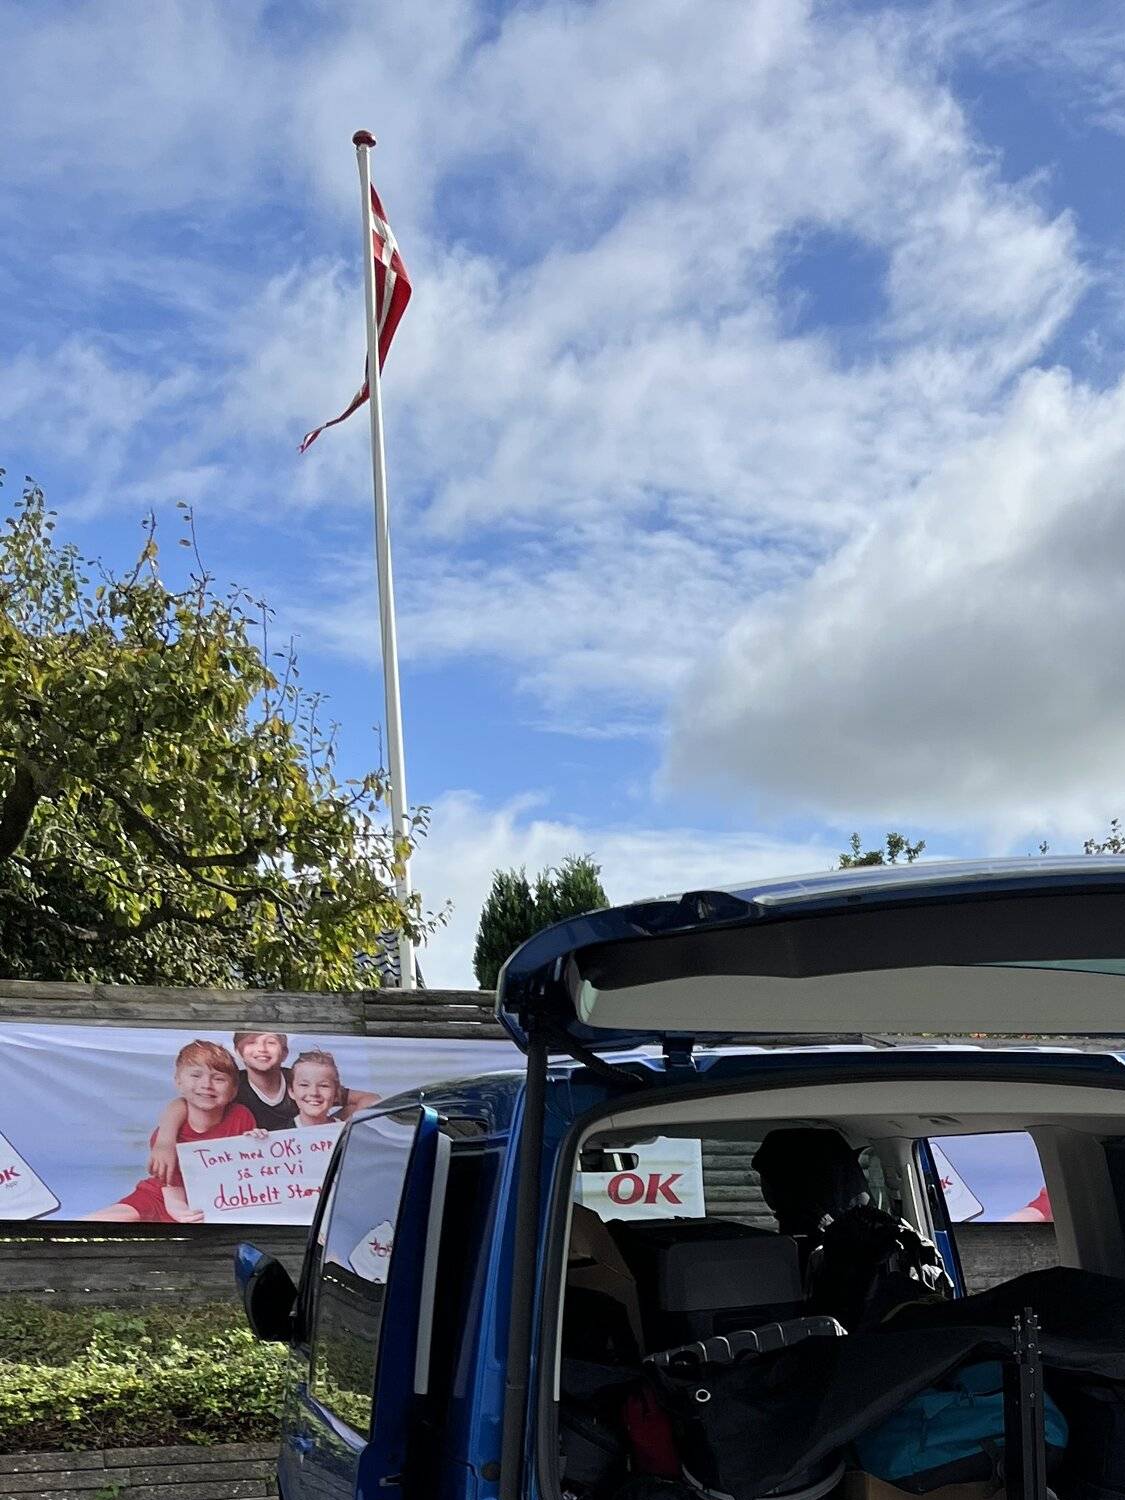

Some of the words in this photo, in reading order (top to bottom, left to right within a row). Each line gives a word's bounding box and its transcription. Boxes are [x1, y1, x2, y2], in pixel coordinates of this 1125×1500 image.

[193, 1149, 233, 1168] Tank
[239, 1150, 264, 1160] med
[310, 1140, 333, 1151] app
[213, 1183, 281, 1210] dobbelt
[607, 1173, 683, 1205] OK
